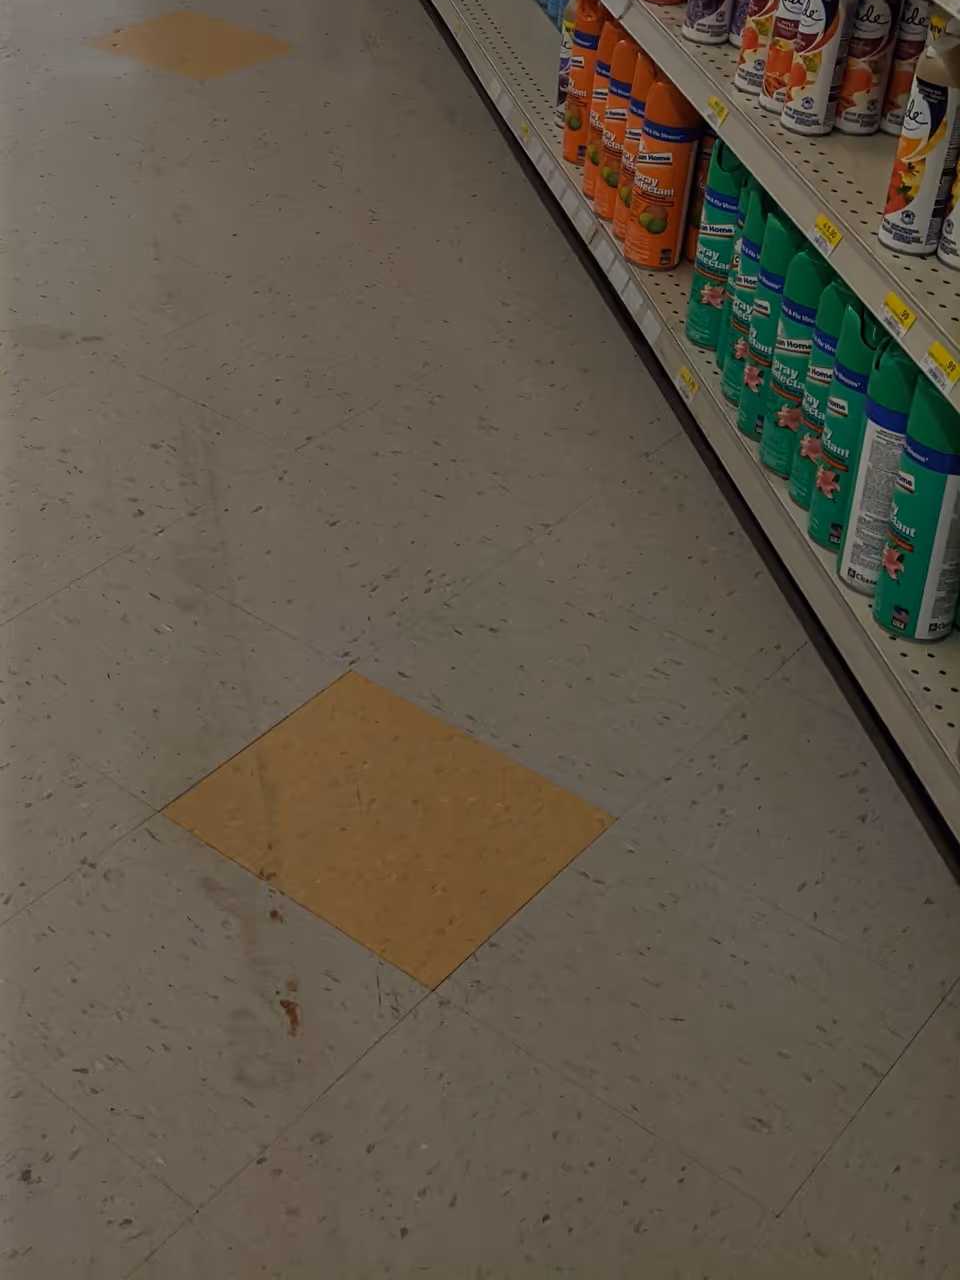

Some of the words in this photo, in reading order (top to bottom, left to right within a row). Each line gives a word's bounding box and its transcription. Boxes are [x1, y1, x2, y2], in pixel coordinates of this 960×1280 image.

[648, 154, 672, 162] Home
[709, 226, 734, 234] Home
[786, 340, 812, 351] Home
[811, 368, 833, 380] Home
[829, 399, 847, 412] ome
[897, 473, 914, 487] ome
